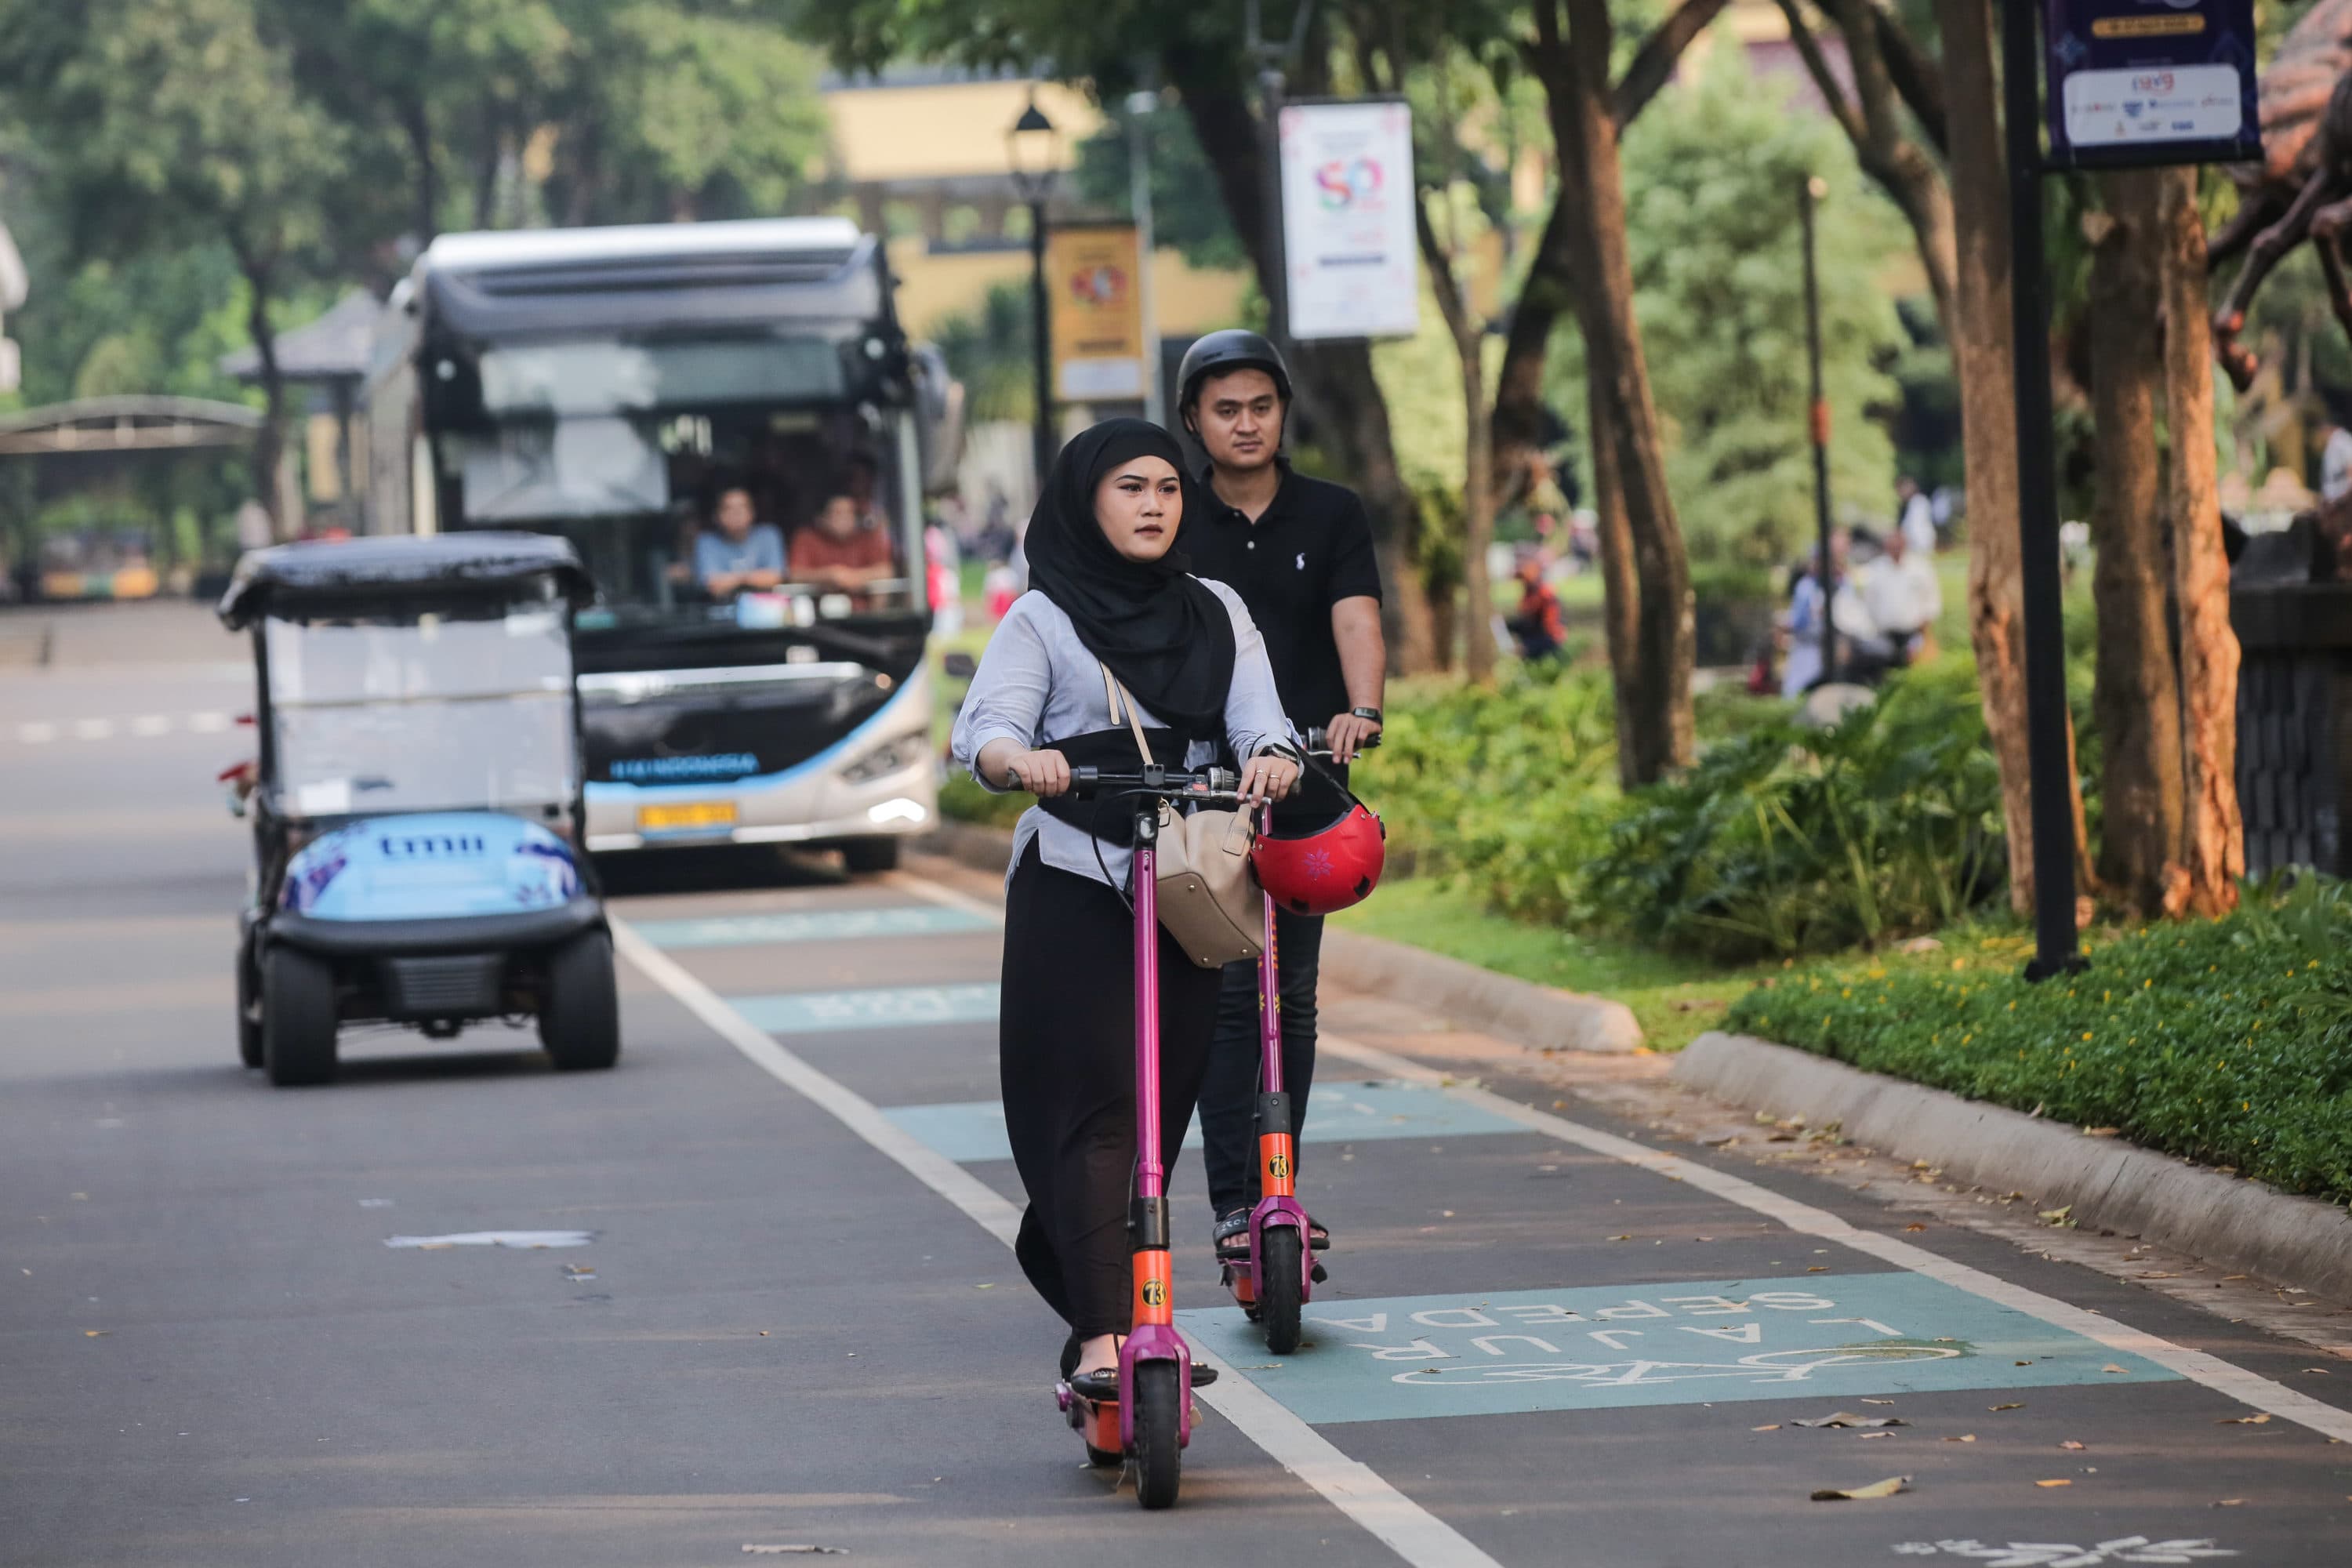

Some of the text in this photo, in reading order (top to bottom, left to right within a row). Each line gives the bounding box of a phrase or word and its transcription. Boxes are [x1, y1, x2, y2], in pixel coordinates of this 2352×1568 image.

[1272, 1157, 1287, 1176] 78
[1145, 1283, 1164, 1305] 73
[1307, 1291, 1835, 1332] SEPEDA
[1346, 1318, 1904, 1361] LAJUR
